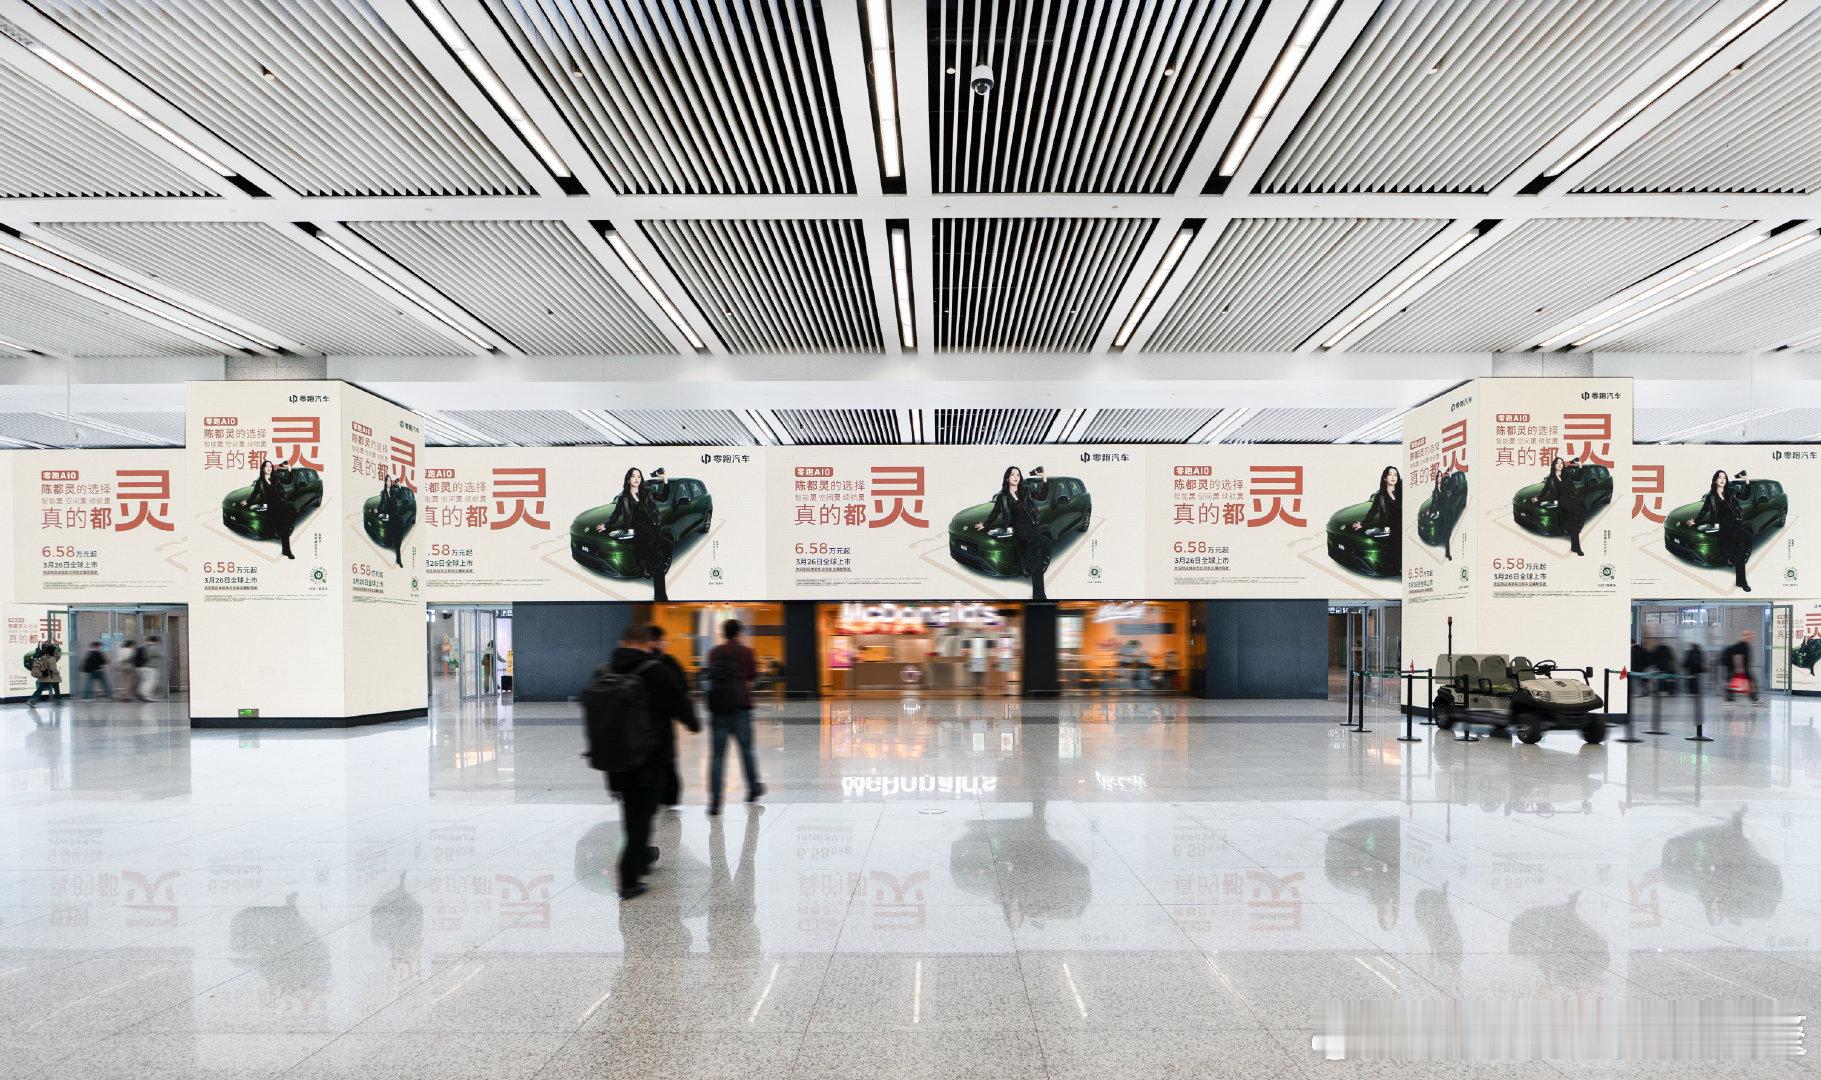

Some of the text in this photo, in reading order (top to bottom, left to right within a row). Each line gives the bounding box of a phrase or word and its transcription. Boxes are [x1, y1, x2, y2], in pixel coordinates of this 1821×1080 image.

[299, 395, 330, 403] 零跑汽车
[204, 428, 267, 439] 陈都灵的选择
[1496, 425, 1559, 436] 陈都灵的选择
[272, 417, 324, 471] 灵
[1563, 414, 1614, 468] 灵
[204, 450, 268, 470] 真的都
[713, 454, 750, 463] 零跑汽车
[1092, 453, 1130, 462] 零跑汽车
[1496, 447, 1560, 467] 真的都
[1783, 451, 1818, 460] 零跑汽车
[796, 467, 831, 476] 零跑A10
[1176, 467, 1210, 475] 零跑A10
[41, 484, 111, 495] 陈都灵的选择
[425, 481, 487, 493] 都灵的选择
[795, 480, 865, 491] 陈都灵的选择
[1174, 479, 1244, 490] 陈都灵的选择
[115, 470, 175, 532] 灵
[490, 468, 550, 530] 灵
[869, 467, 929, 528] 灵
[1247, 466, 1307, 528] 灵
[42, 507, 112, 530] 真的都
[425, 505, 488, 528] 真的都
[795, 503, 867, 526] 真的都
[1173, 503, 1245, 525] 真的都
[43, 561, 98, 569] 3月26日全球上市
[796, 558, 851, 566] 3月26日全球上市
[1174, 556, 1229, 564] 3月26日全球上市
[204, 576, 258, 584] 3月26日全球上市
